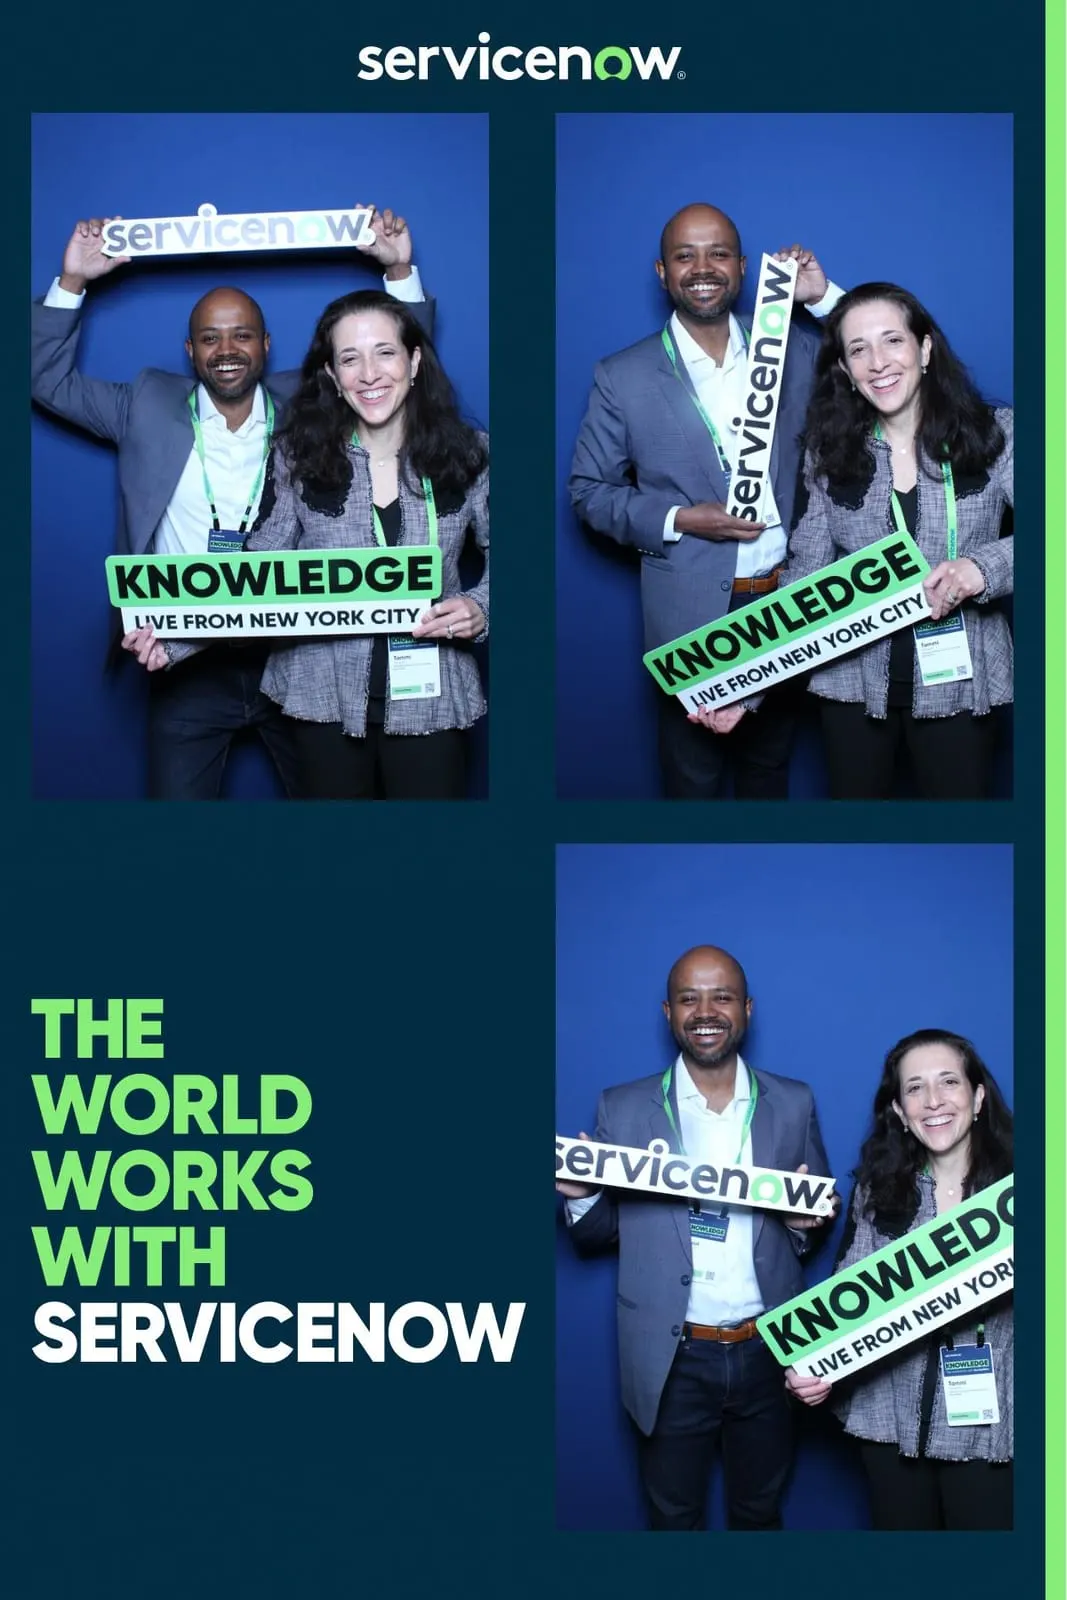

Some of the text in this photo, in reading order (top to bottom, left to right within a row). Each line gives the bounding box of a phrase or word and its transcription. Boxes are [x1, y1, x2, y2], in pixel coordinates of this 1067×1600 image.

[107, 207, 366, 252] servicenow
[115, 555, 433, 599] KNOWLEDGE
[183, 613, 244, 630] FROM
[251, 611, 299, 628] NEW
[305, 609, 365, 626] YORK
[371, 607, 421, 625] CITY
[652, 541, 921, 687] KNOWLEDGE
[690, 593, 925, 708] LIVE FROM NEW YORK CITY
[690, 1223, 725, 1236] NOWLEDGE
[808, 1347, 854, 1378] LIVE
[851, 1318, 913, 1357] FROM
[912, 1287, 962, 1325] NEW
[945, 1359, 989, 1369] KNOWLEDGE
